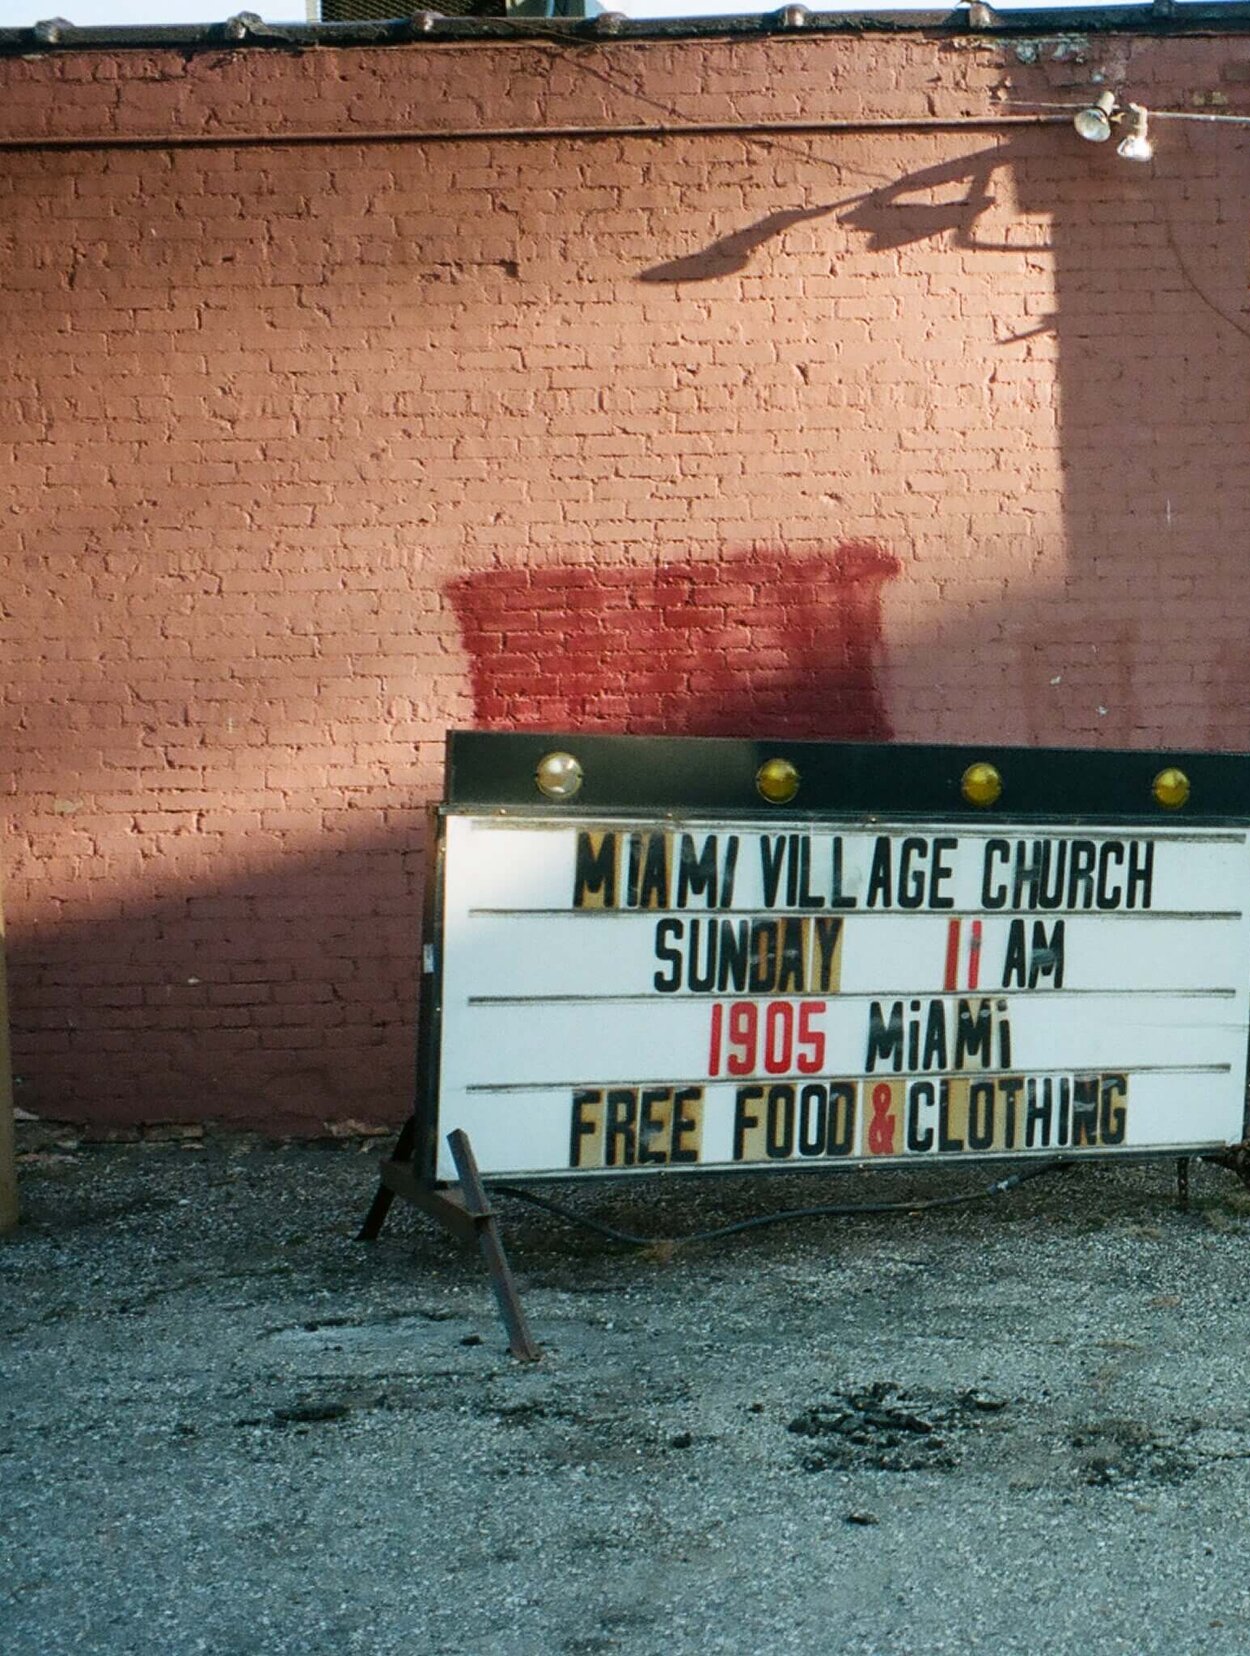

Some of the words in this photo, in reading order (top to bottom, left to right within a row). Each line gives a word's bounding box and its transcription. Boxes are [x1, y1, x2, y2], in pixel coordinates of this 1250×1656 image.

[573, 832, 739, 908] MIAMI
[760, 834, 957, 908] VILLAGE
[981, 839, 1154, 908] CHURCH
[654, 917, 843, 992] SUNDAY
[944, 918, 982, 990] 11
[1002, 918, 1065, 989] AM
[708, 1001, 826, 1076] 1905
[569, 1086, 702, 1167] FREE
[733, 1082, 856, 1161] FOOD
[868, 1083, 895, 1154] &
[907, 1074, 1127, 1152] CLOTHING
